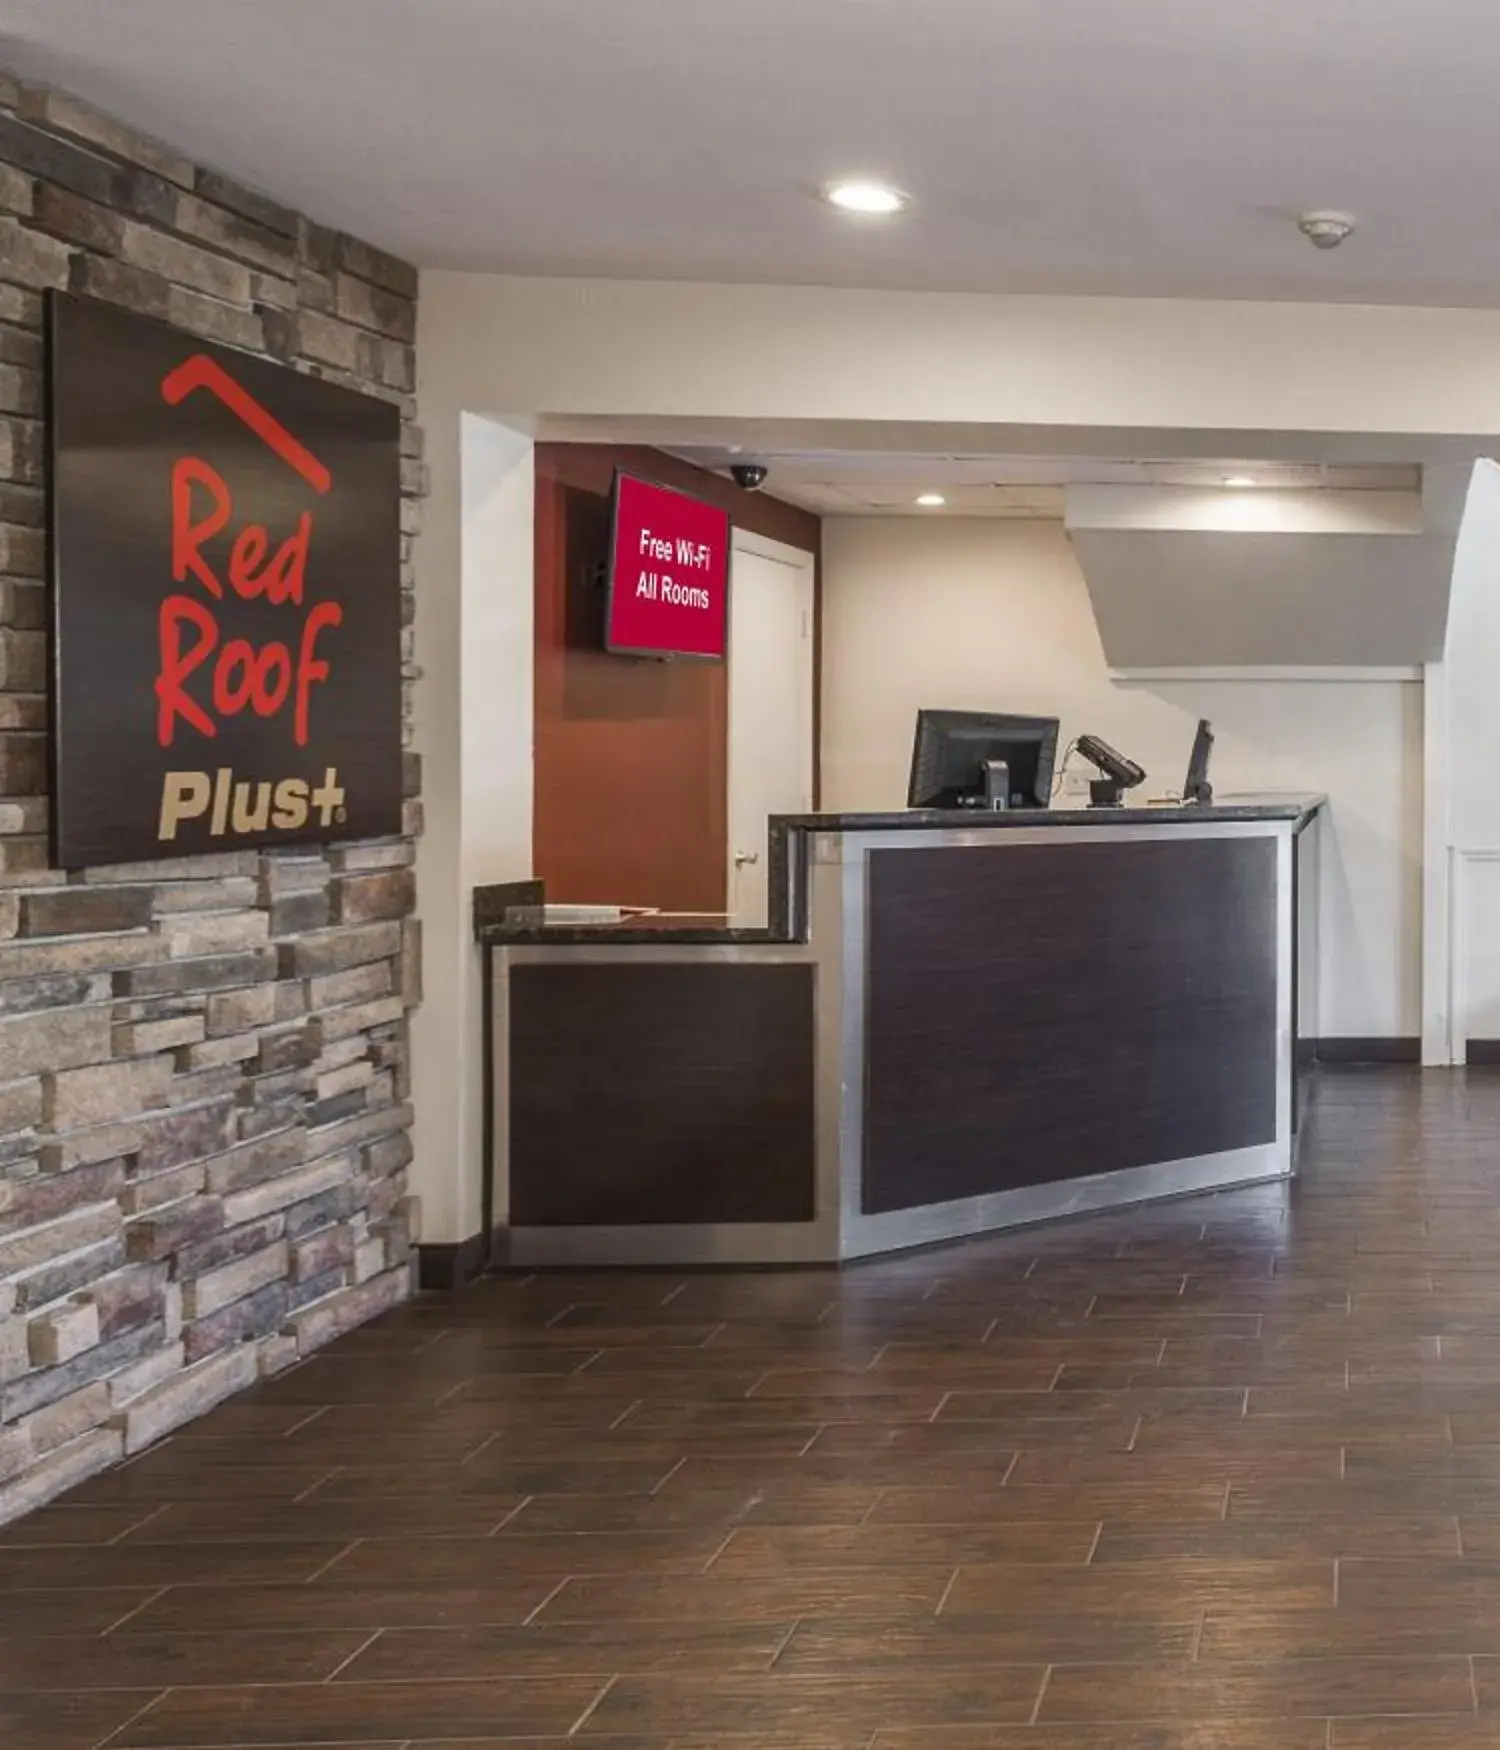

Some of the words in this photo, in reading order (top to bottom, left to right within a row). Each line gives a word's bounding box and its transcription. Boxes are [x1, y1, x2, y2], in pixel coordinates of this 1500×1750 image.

[172, 456, 313, 605] Red
[639, 529, 673, 561] Free
[676, 538, 711, 571] Wi-Fi
[635, 571, 657, 600] All
[661, 575, 710, 609] Rooms
[154, 597, 342, 747] Roof
